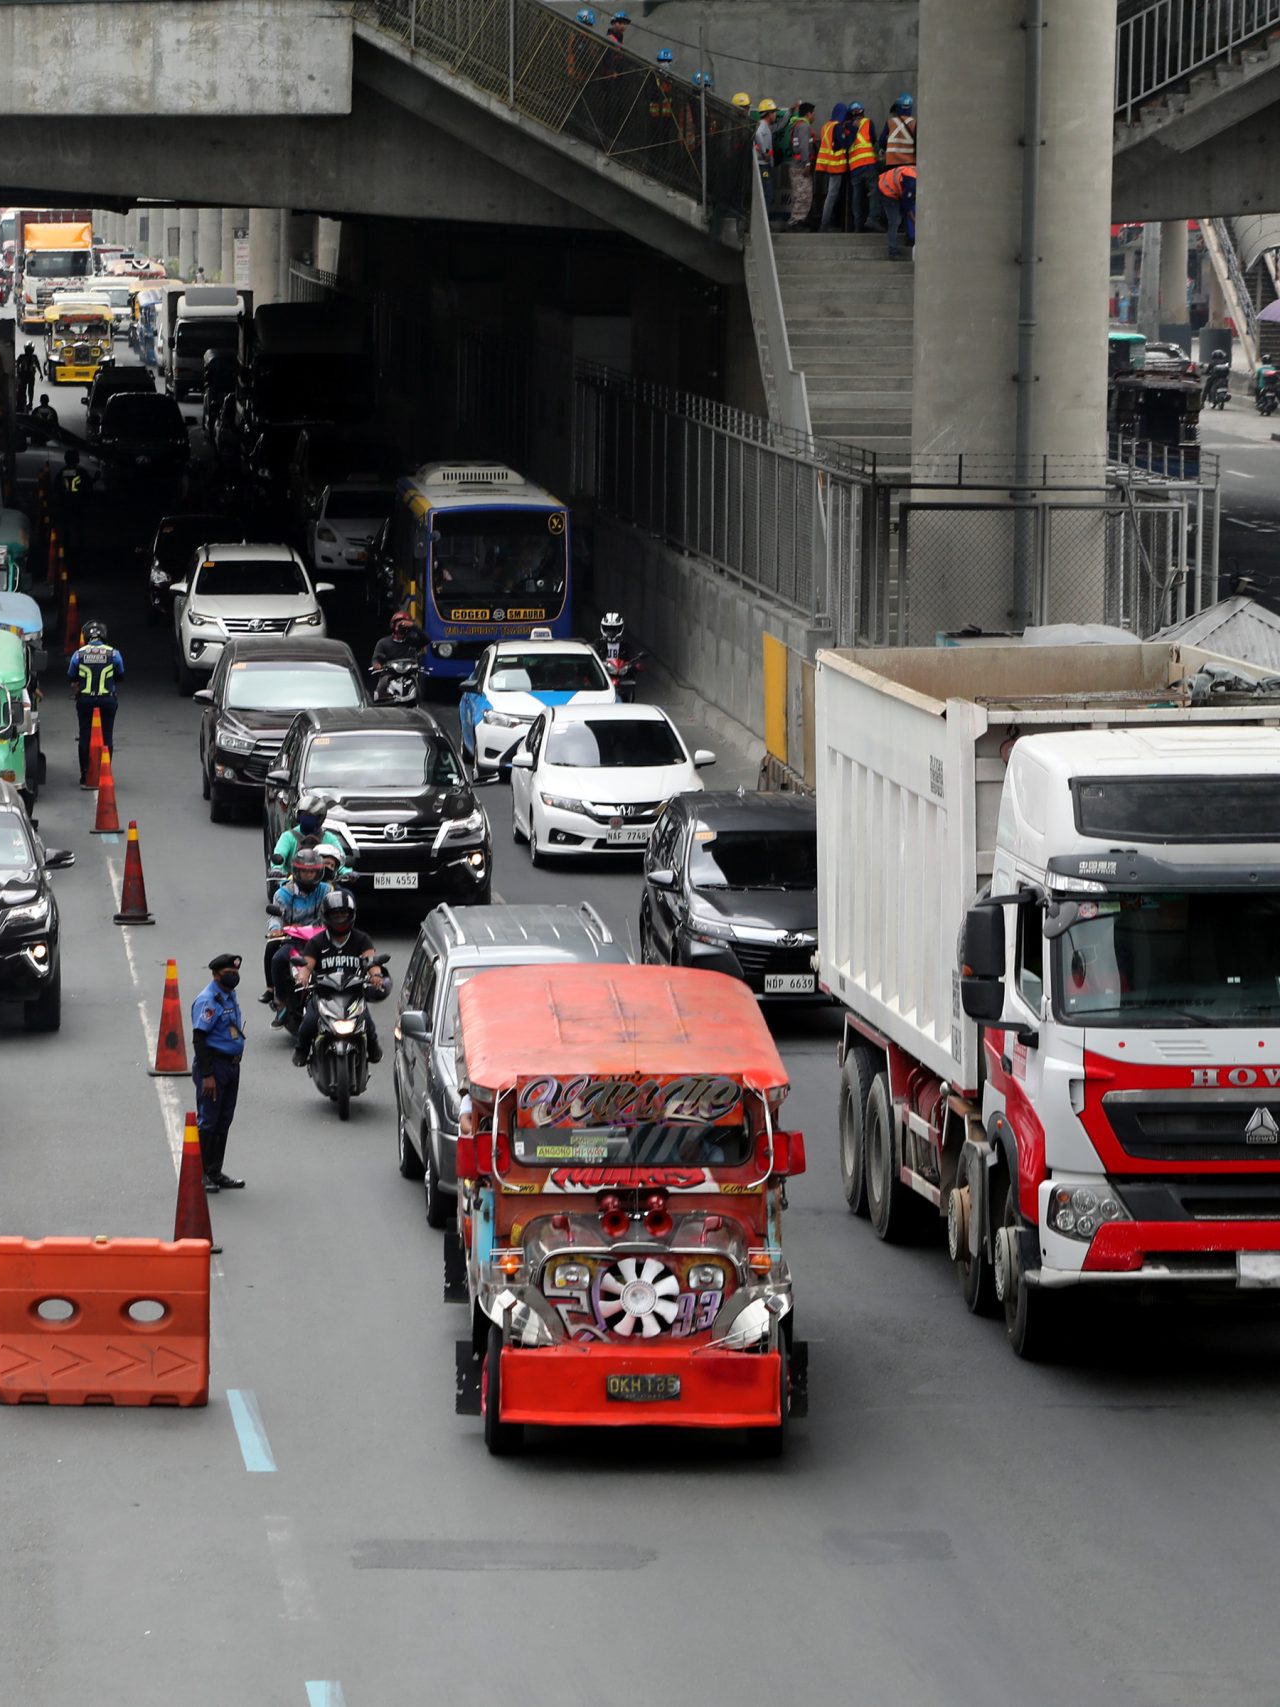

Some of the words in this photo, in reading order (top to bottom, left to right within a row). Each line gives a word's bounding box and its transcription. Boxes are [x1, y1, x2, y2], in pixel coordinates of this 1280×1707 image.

[453, 610, 488, 619] COGEO
[508, 610, 521, 619] SM
[522, 610, 544, 619] AURA
[607, 832, 622, 841] NAF
[375, 875, 391, 885] NBN
[395, 875, 417, 886] 4552
[766, 977, 784, 988] NDP
[789, 977, 814, 988] 6639
[538, 1147, 571, 1156] ANGONO
